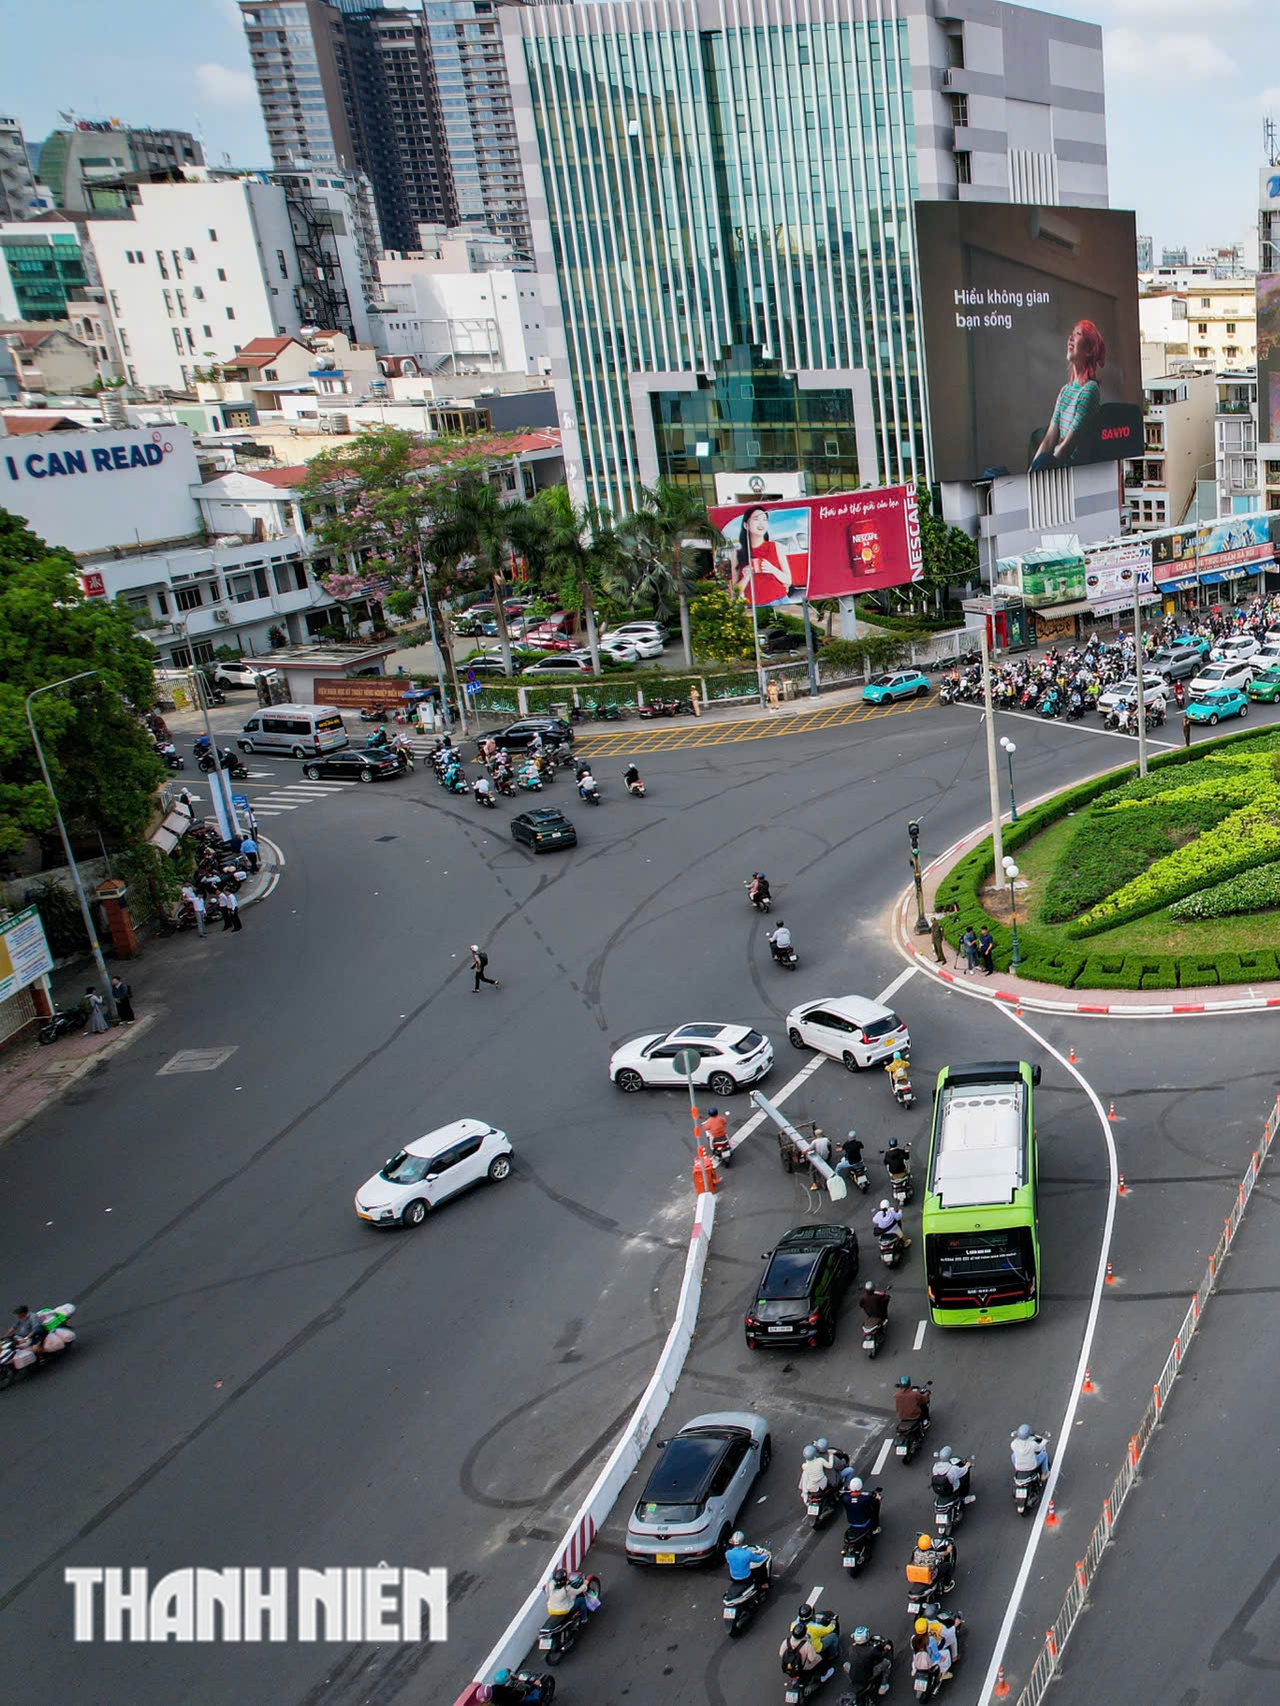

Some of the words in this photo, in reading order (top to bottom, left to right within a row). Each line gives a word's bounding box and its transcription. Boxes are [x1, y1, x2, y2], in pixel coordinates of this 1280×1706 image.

[954, 288, 984, 305] Hiểu
[987, 289, 1023, 307] không
[1026, 290, 1050, 307] gian
[956, 312, 980, 330] bạn
[984, 310, 1012, 329] sống
[1101, 426, 1130, 440] SANYO
[5, 456, 19, 480] I
[25, 450, 88, 478] CAN
[91, 443, 164, 472] READ
[889, 498, 899, 508] bạn
